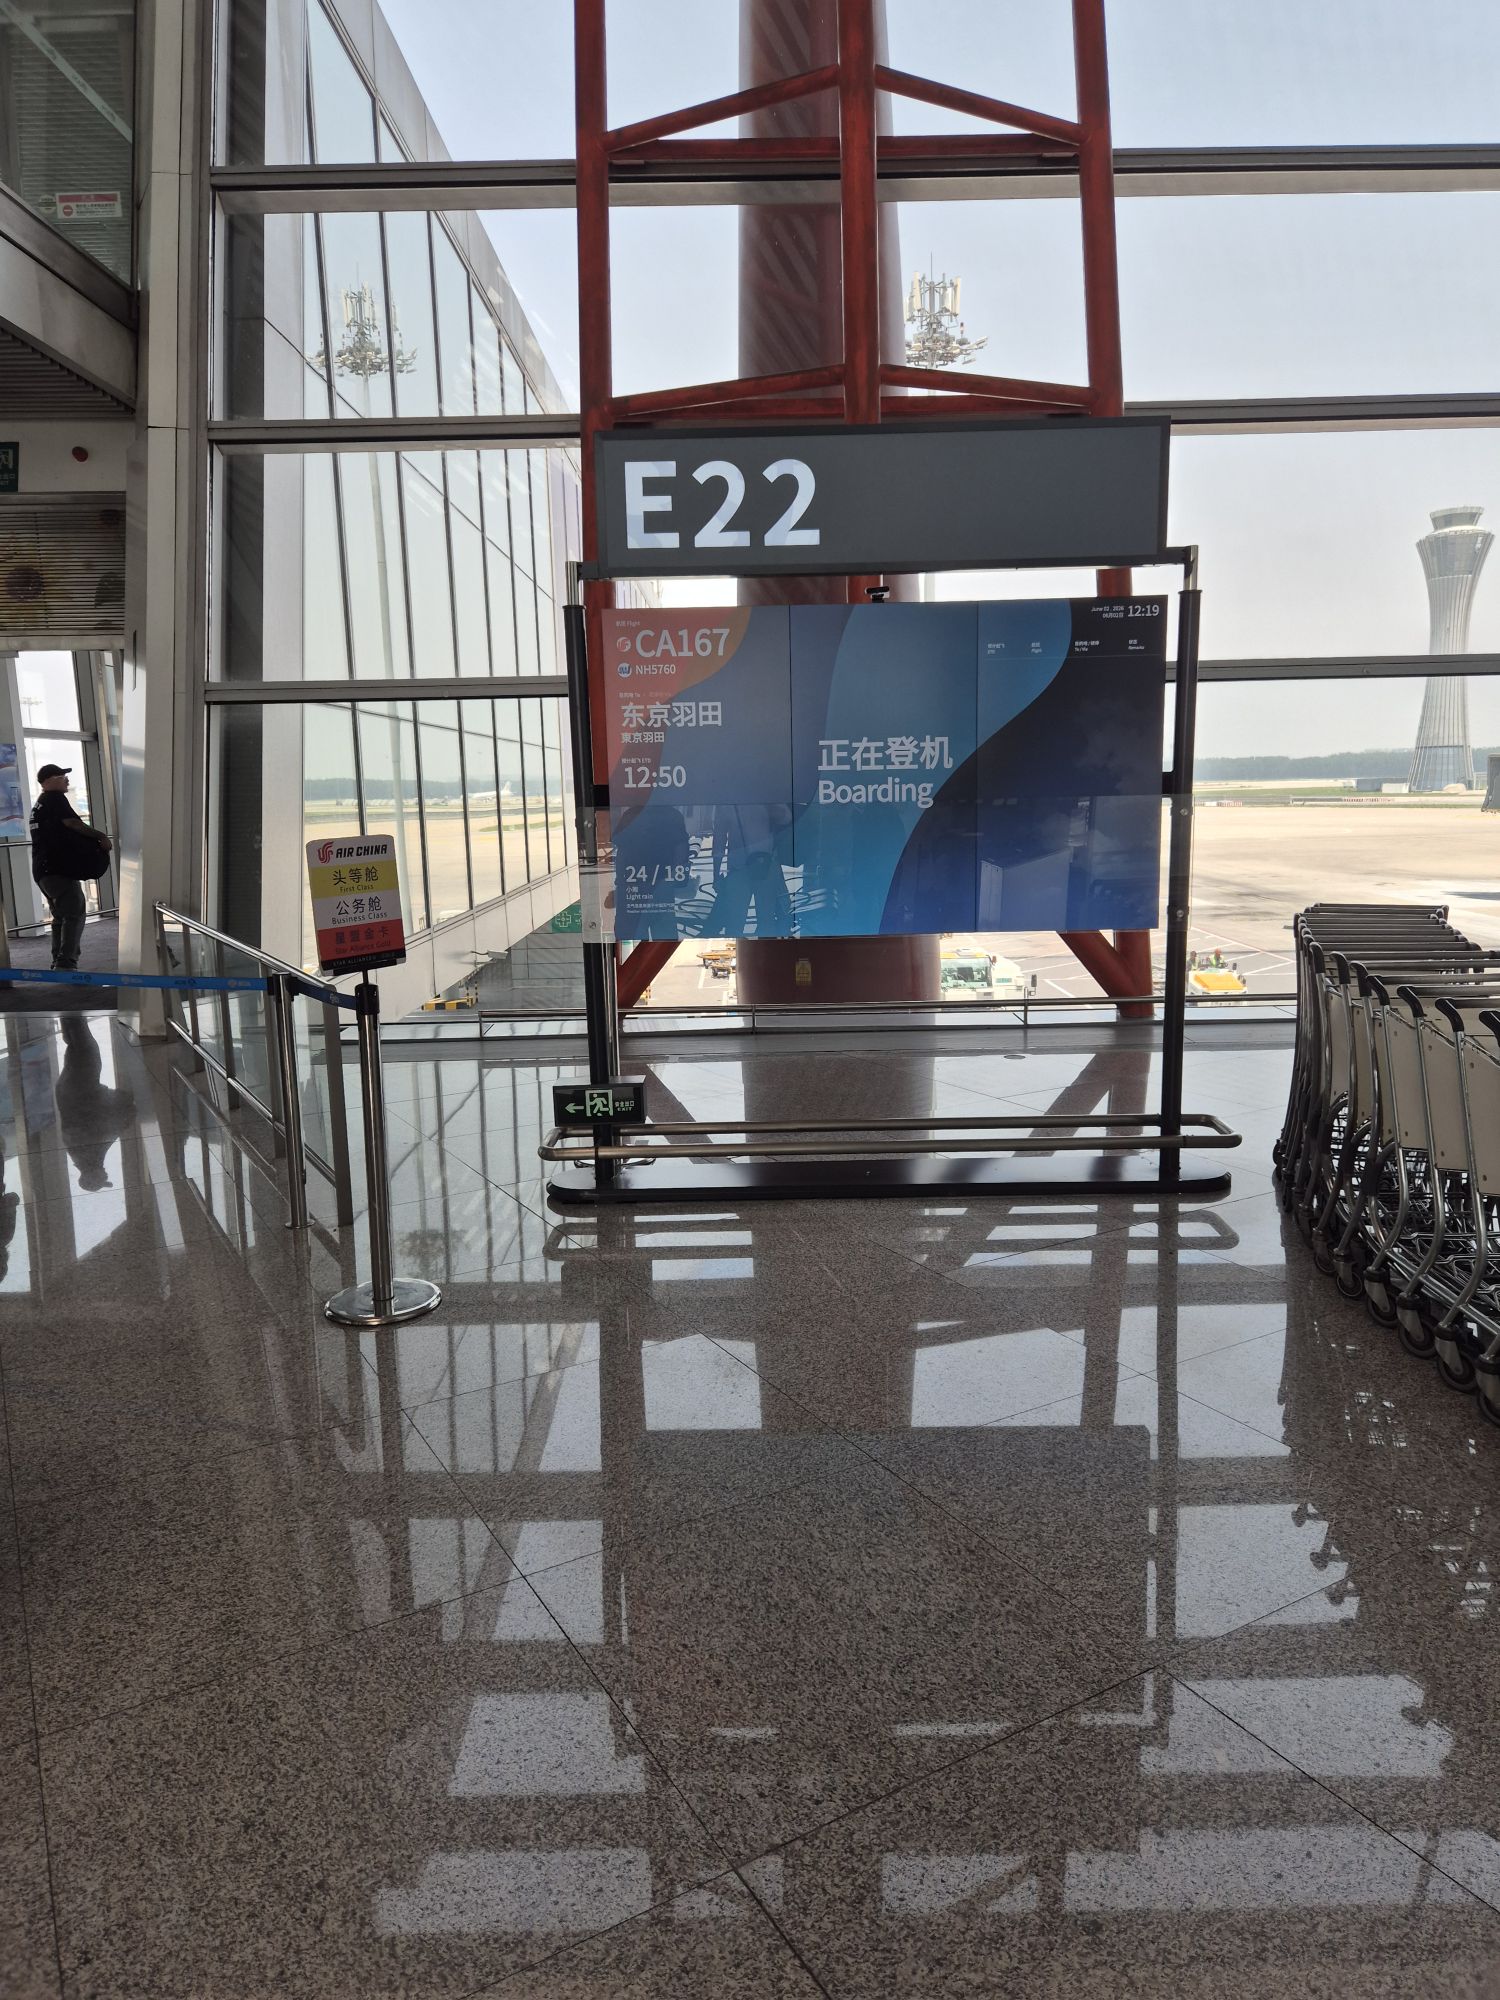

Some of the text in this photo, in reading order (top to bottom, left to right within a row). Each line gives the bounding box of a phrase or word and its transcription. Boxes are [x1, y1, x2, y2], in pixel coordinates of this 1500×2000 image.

[624, 458, 820, 549] E22
[1128, 604, 1160, 617] 12:19
[635, 628, 730, 658] CA167
[635, 664, 676, 675] NH5760
[621, 701, 723, 728] 东京羽田
[620, 731, 666, 744] 東京羽田
[818, 735, 953, 771] 正在登机
[624, 765, 687, 788] 12:50
[818, 777, 934, 808] Boarding
[336, 844, 388, 859] AIR CHINA
[333, 866, 379, 886] 头等舱
[625, 865, 648, 883] 24
[336, 895, 382, 916] 公务舱
[626, 893, 641, 901] Light
[332, 911, 388, 925] Business Class
